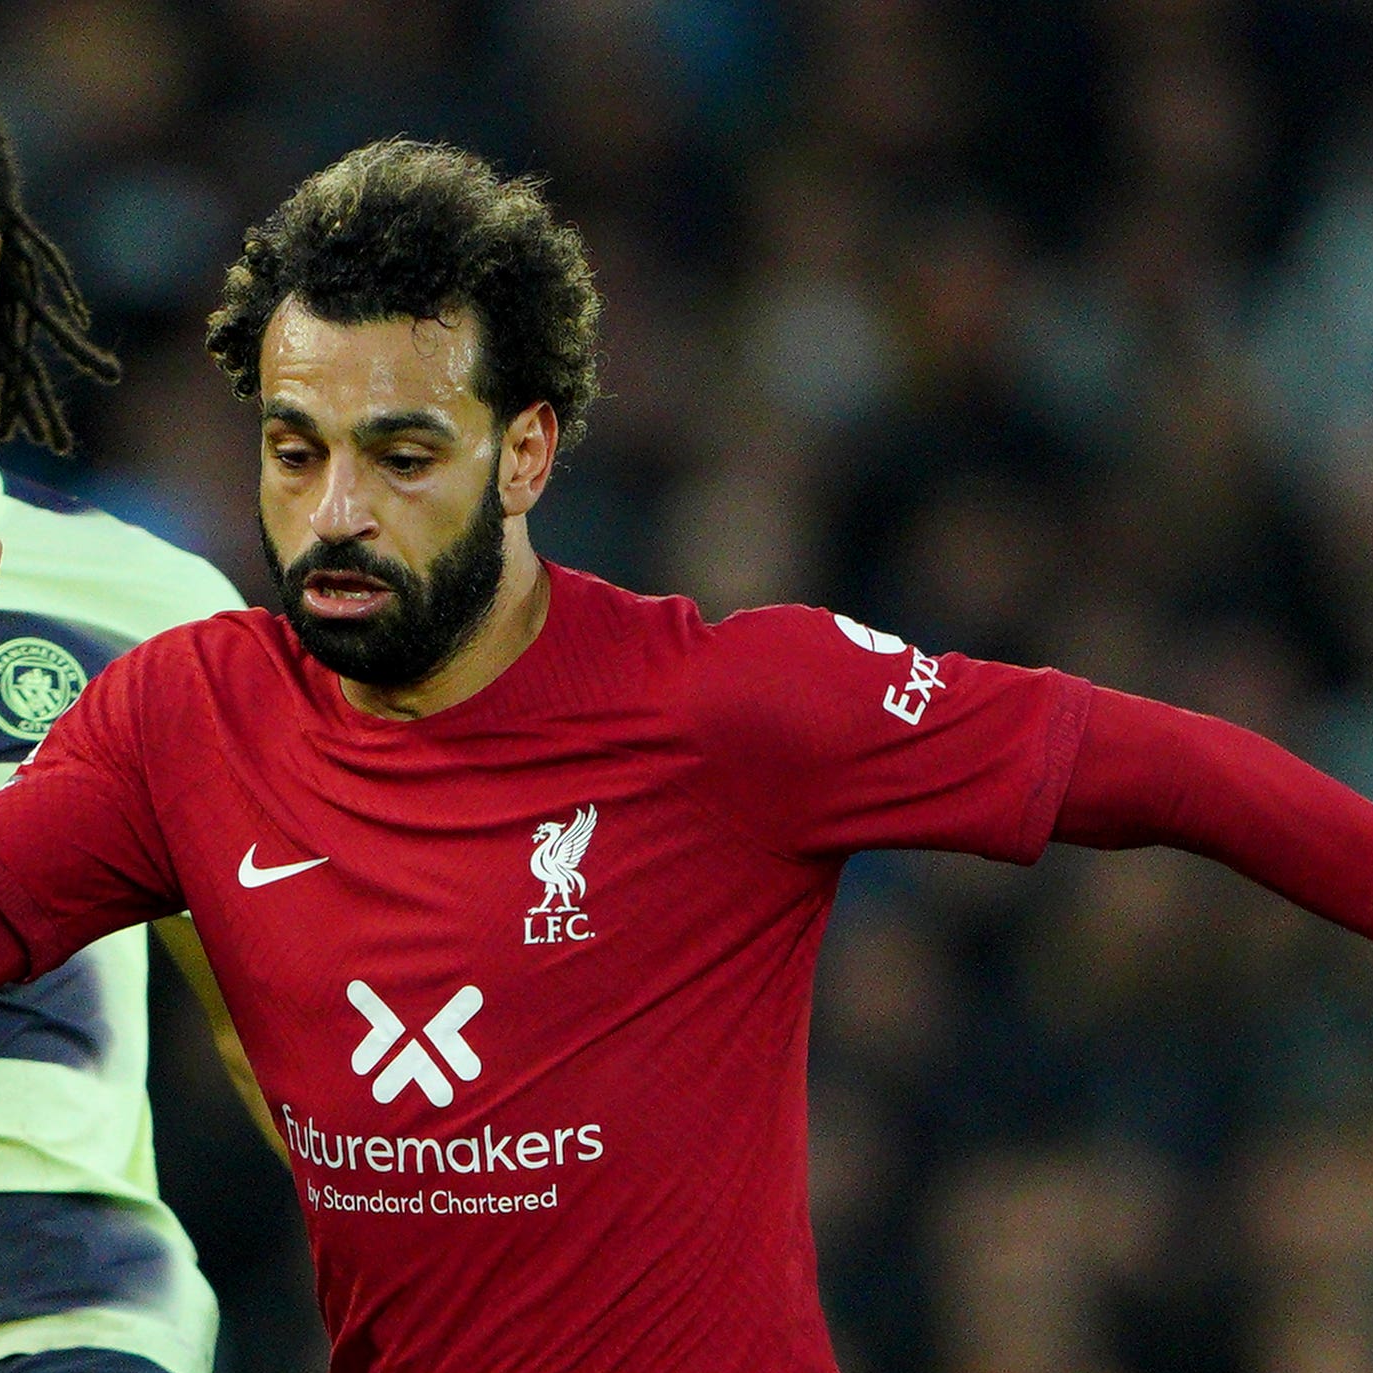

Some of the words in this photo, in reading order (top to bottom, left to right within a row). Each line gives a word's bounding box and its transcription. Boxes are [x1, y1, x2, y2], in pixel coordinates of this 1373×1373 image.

[882, 645, 947, 726] Exp
[523, 913, 596, 945] L.F.C.
[307, 1177, 321, 1212] by
[323, 1184, 424, 1215] Standard
[430, 1183, 558, 1215] Chartered
